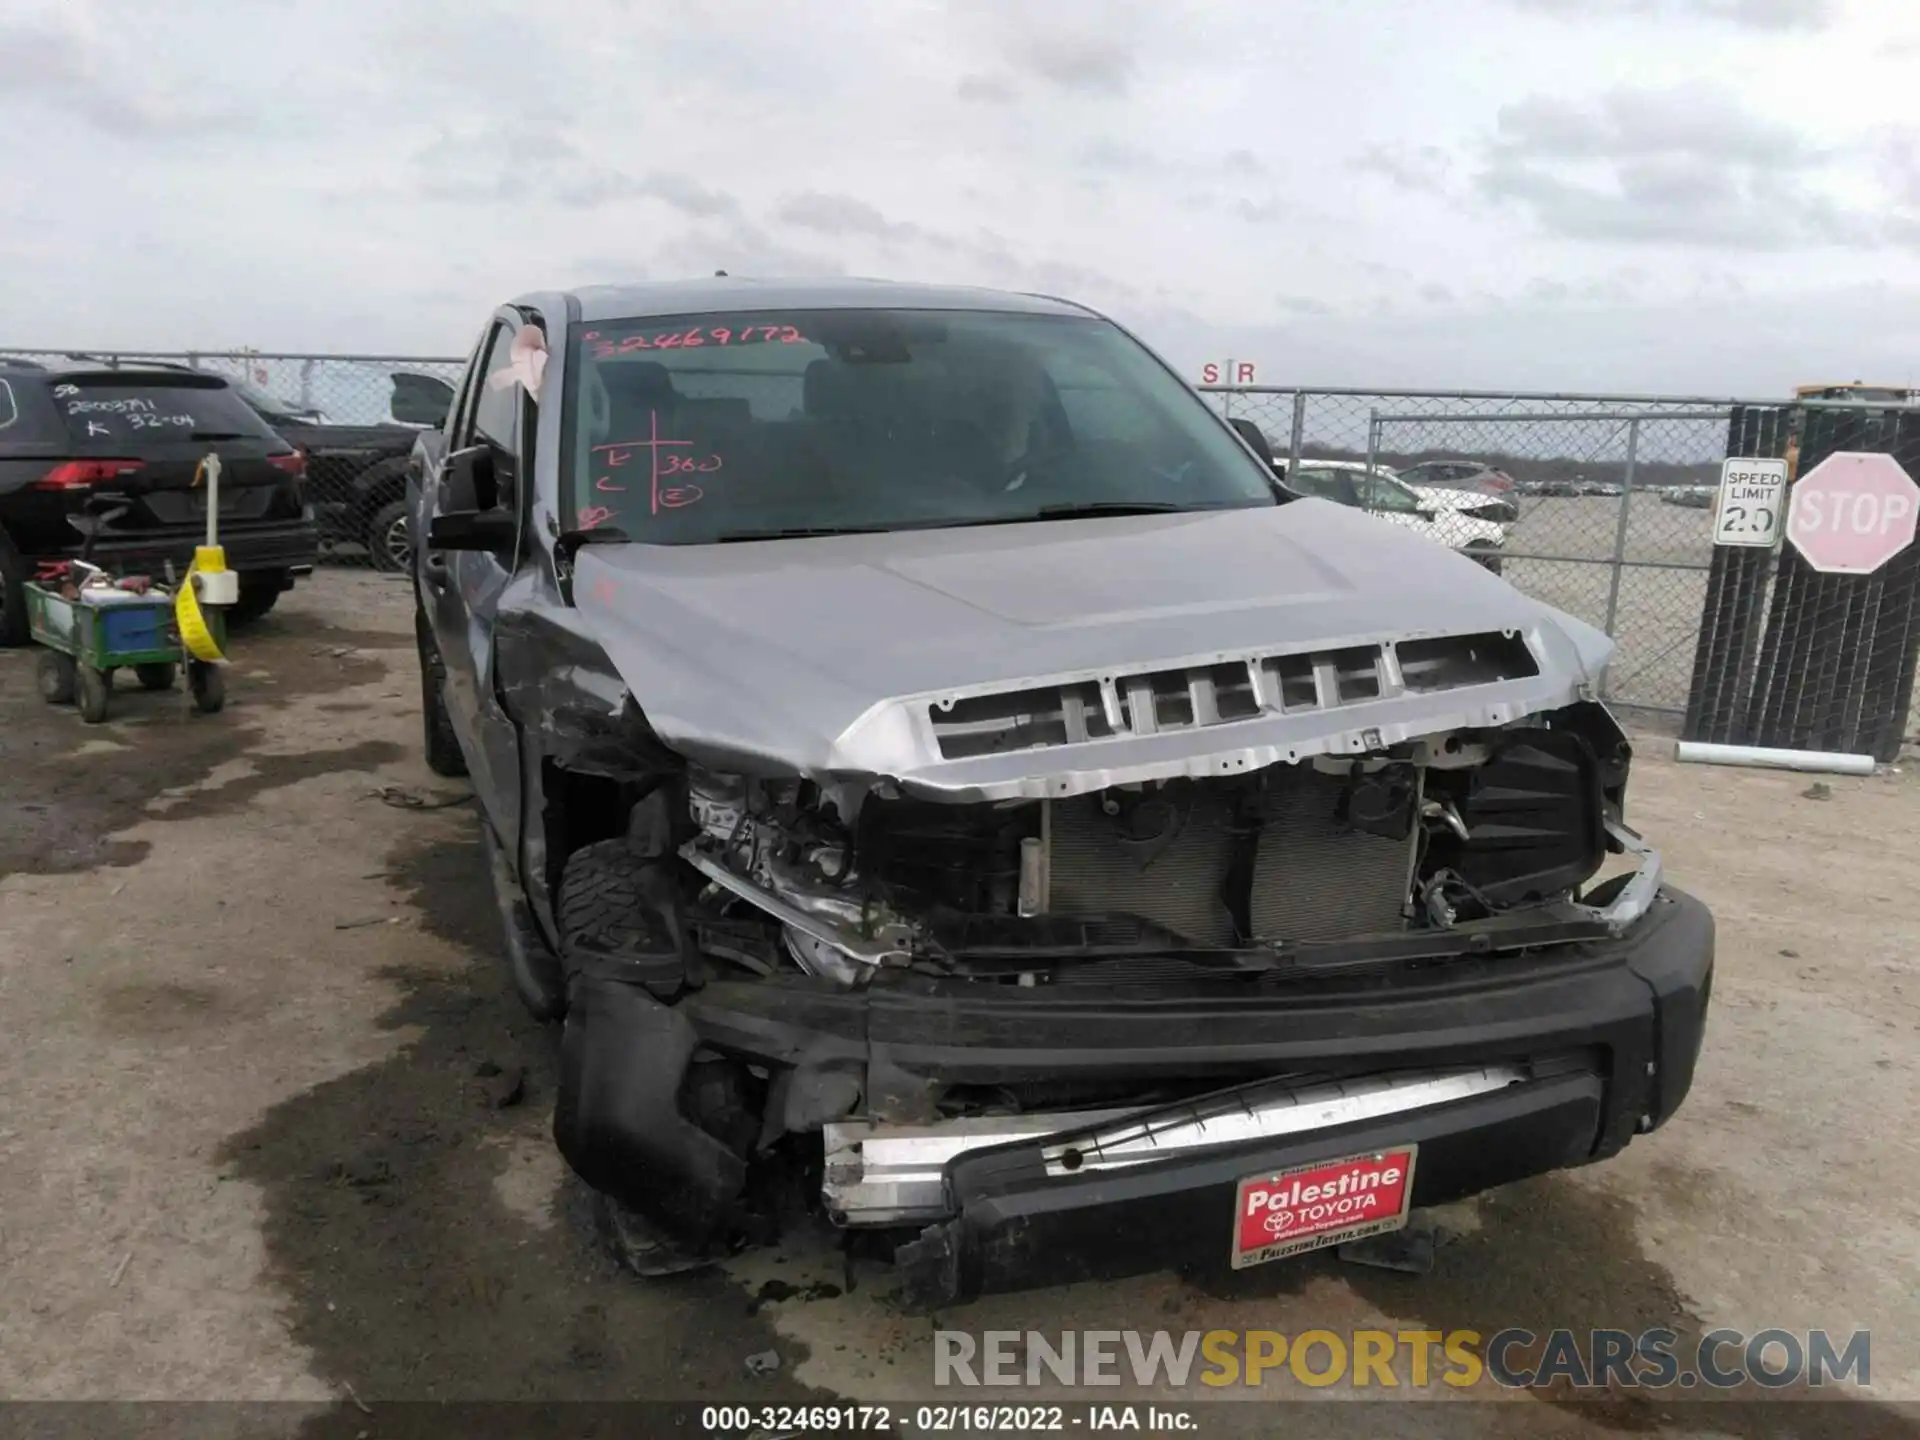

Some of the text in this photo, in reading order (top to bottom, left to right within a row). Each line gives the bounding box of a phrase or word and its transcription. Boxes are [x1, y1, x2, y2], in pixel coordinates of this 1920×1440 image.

[1203, 363, 1255, 383] S R
[1727, 472, 1782, 486] SPEED
[1731, 487, 1775, 501] LIMIT
[1799, 490, 1911, 535] STOP
[1247, 1167, 1400, 1216] Palestine
[1298, 1193, 1377, 1222] TOYOTA
